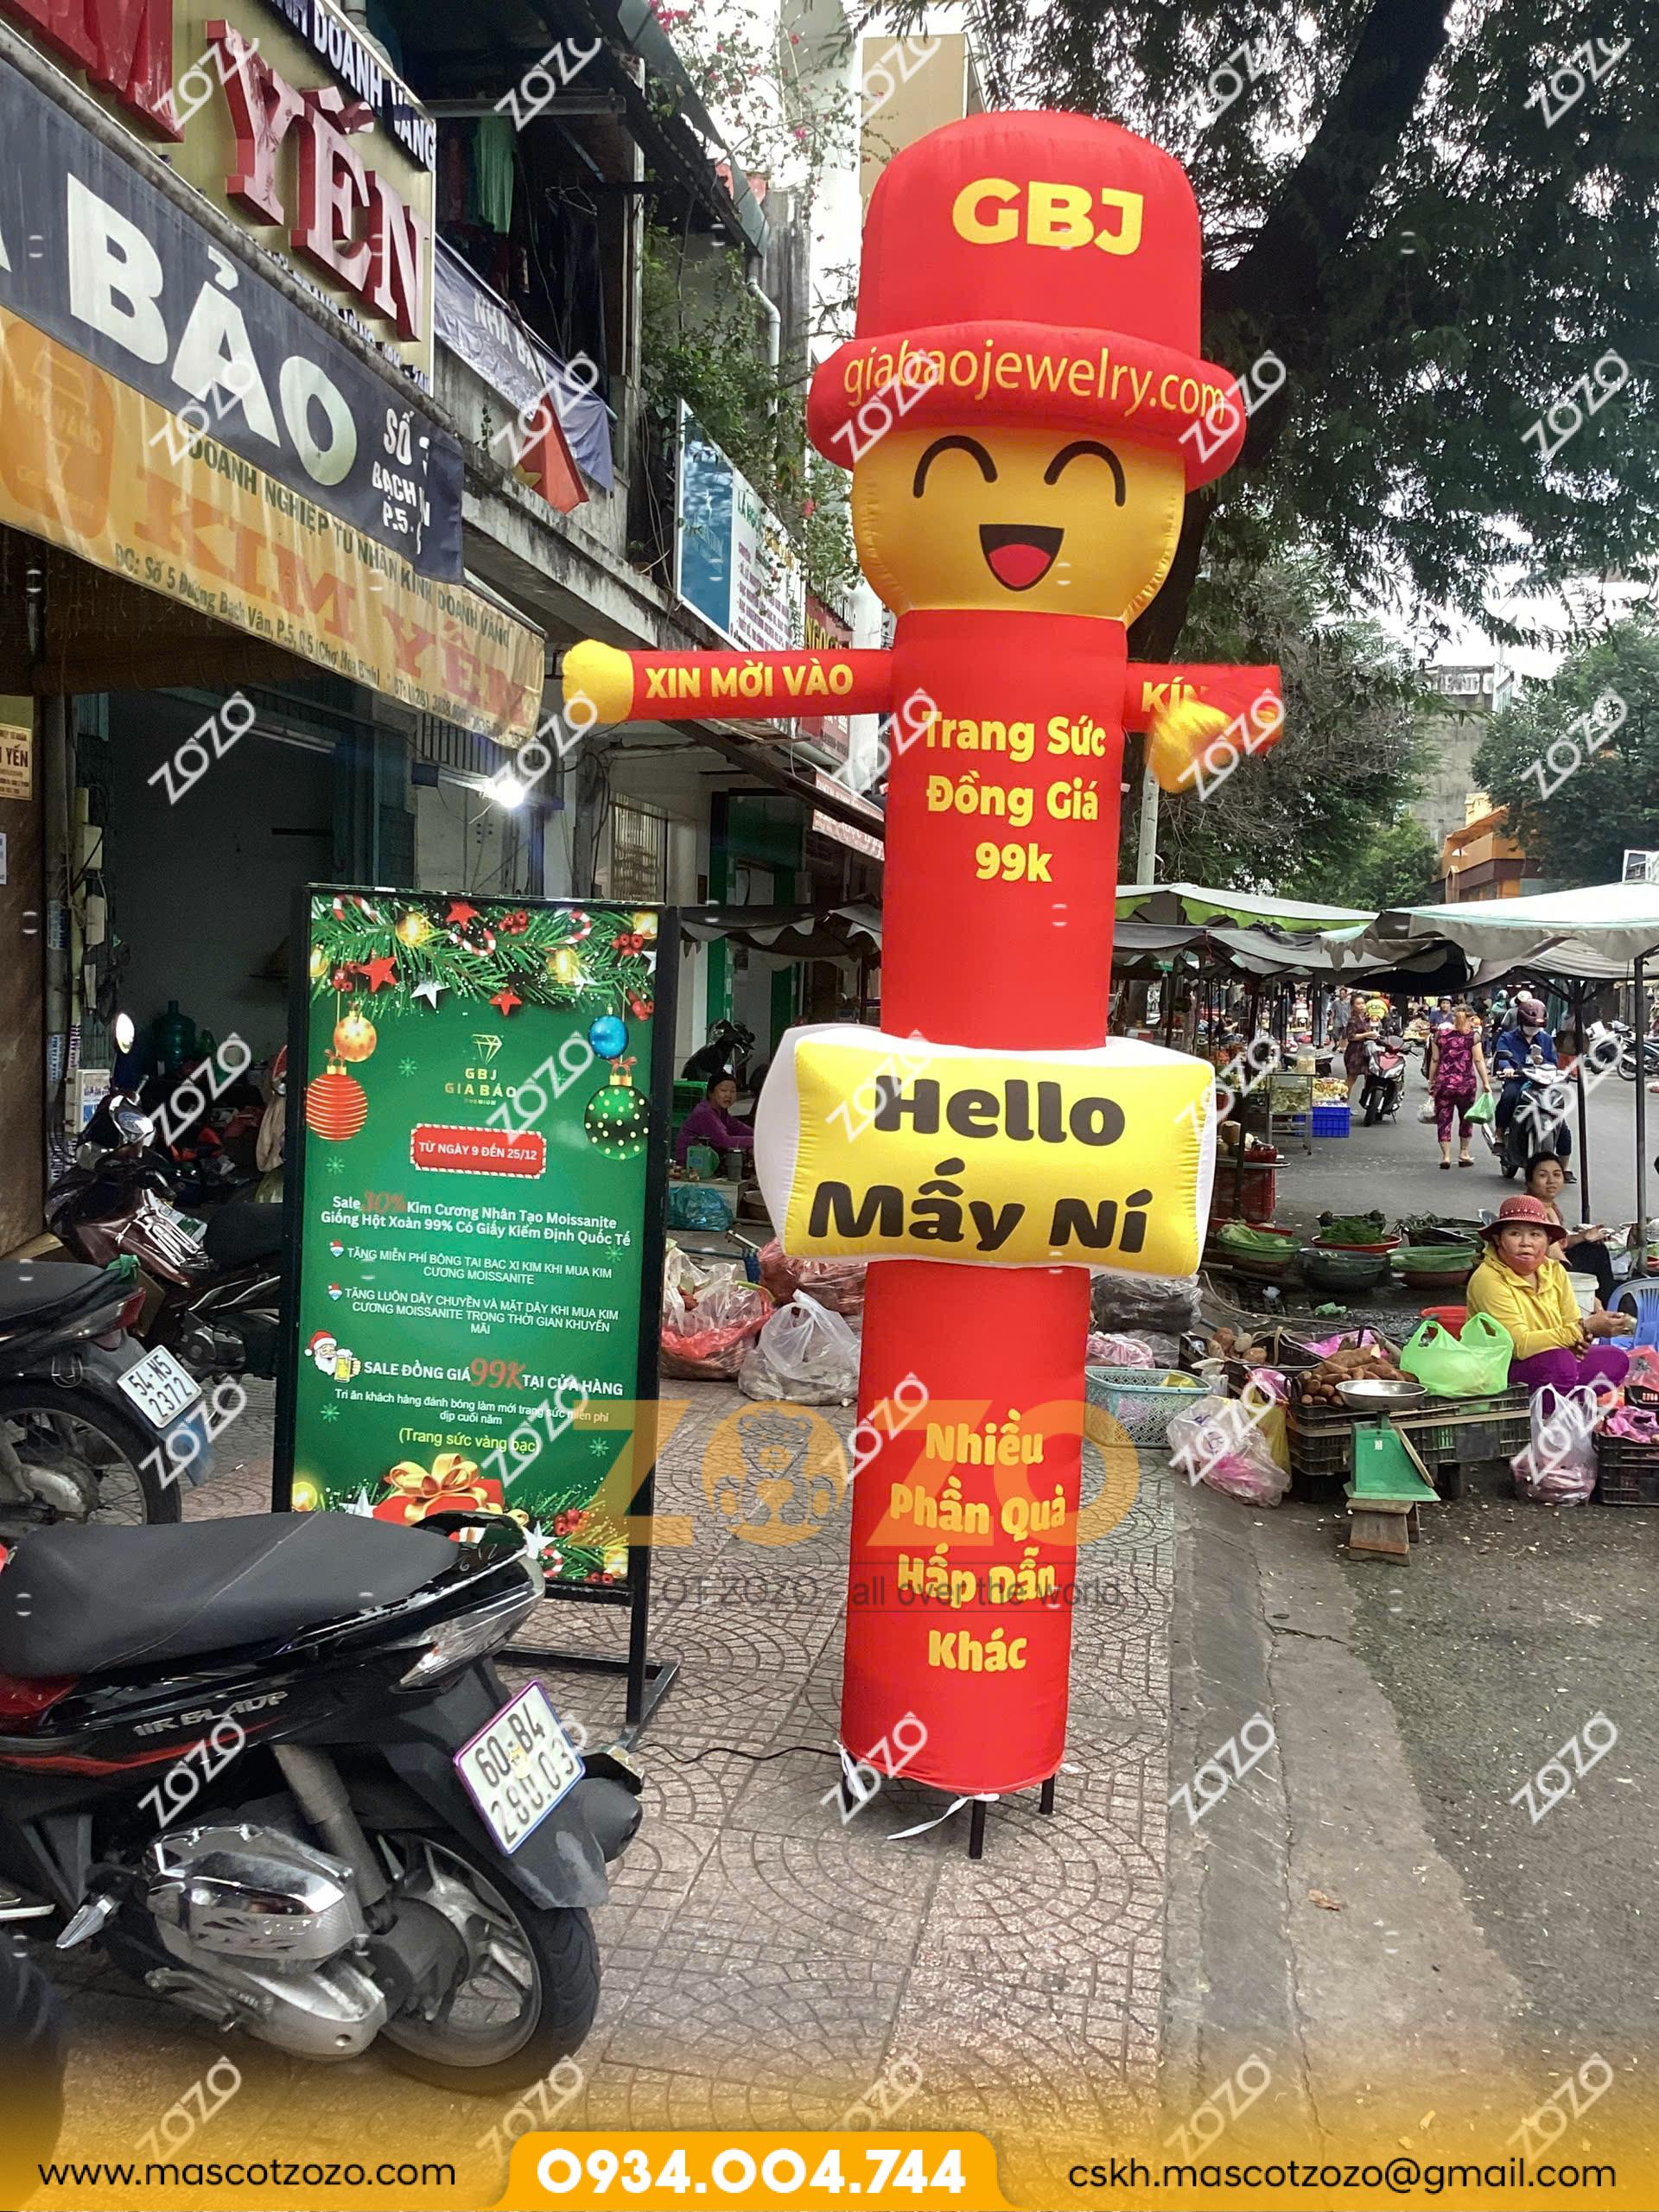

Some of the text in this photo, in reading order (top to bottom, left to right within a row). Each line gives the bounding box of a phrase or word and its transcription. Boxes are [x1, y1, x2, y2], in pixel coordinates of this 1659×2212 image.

[952, 177, 1143, 256] GBJ
[68, 172, 357, 486] BẢO
[843, 340, 1225, 423] giabaojewelry.com
[384, 410, 415, 466] SỐ
[372, 461, 417, 508] BẠCH
[264, 480, 329, 537] NGHIỆP
[645, 658, 854, 699] XIN MỜI VÀO
[923, 711, 1107, 763] Trang Sức
[926, 770, 1033, 827] Đồng
[1046, 779, 1099, 823] Giá
[975, 842, 1052, 884] 99k
[445, 1082, 516, 1098] GIA BẢO
[465, 1068, 497, 1080] GBJ
[874, 1075, 1126, 1147] Hello
[418, 1140, 537, 1160] TỪ NGÀY 9 ĐẾN 25/12
[333, 1195, 360, 1210] Sale
[407, 1201, 431, 1214] Kim
[435, 1204, 479, 1221] Cương
[481, 1206, 516, 1221] Nhân
[518, 1210, 543, 1224] Tạo
[546, 1211, 617, 1230] Moissanite
[808, 1157, 1154, 1253] Mấy Ní
[321, 1209, 631, 1247] Giống Hột Xoàn 99% Có Giấy Kiểm Định Quốc Tế
[379, 1248, 406, 1262] MIỄN
[409, 1251, 427, 1263] PHÍ
[464, 1256, 481, 1268] TAI
[509, 1260, 519, 1271] XI
[522, 1261, 542, 1273] KIM
[544, 1263, 563, 1274] KHI
[565, 1265, 590, 1277] MUA
[592, 1267, 612, 1279] KIM
[423, 1267, 535, 1286] CƯƠNG MOISSANITE
[353, 1301, 610, 1332] CƯƠNG MOISSANITE TRONG THỜI GIAN KHUYẾN
[378, 1289, 408, 1303] LUÔN
[435, 1294, 480, 1308] CHUYỀN
[483, 1298, 498, 1309] VÀ
[551, 1305, 569, 1316] KHI
[571, 1307, 596, 1319] MUA
[599, 1309, 619, 1321] KIM
[148, 1376, 194, 1418] 2372
[364, 1361, 399, 1376] SALE
[402, 1359, 443, 1380] ĐỒNG
[447, 1366, 471, 1382] GIÁ
[522, 1374, 544, 1390] TẠI
[547, 1373, 579, 1392] CỬA
[582, 1378, 624, 1396] HÀNG
[334, 1389, 347, 1399] Tri
[350, 1390, 363, 1401] ân
[365, 1392, 395, 1403] khách
[397, 1395, 422, 1408] hàng
[423, 1396, 448, 1408] đánh
[450, 1398, 475, 1412] bóng
[477, 1401, 495, 1412] làm
[498, 1402, 517, 1414] mới
[518, 1404, 543, 1419] trang
[439, 1411, 503, 1425] dịp cuối năm
[399, 1427, 442, 1447] (Trang
[446, 1432, 472, 1446] sức
[475, 1435, 507, 1452] vàng
[925, 1408, 1044, 1467] Nhiều
[889, 1476, 990, 1535] Phần
[897, 1541, 1056, 1609] Hấp Dẫn
[928, 1627, 1027, 1674] Khác
